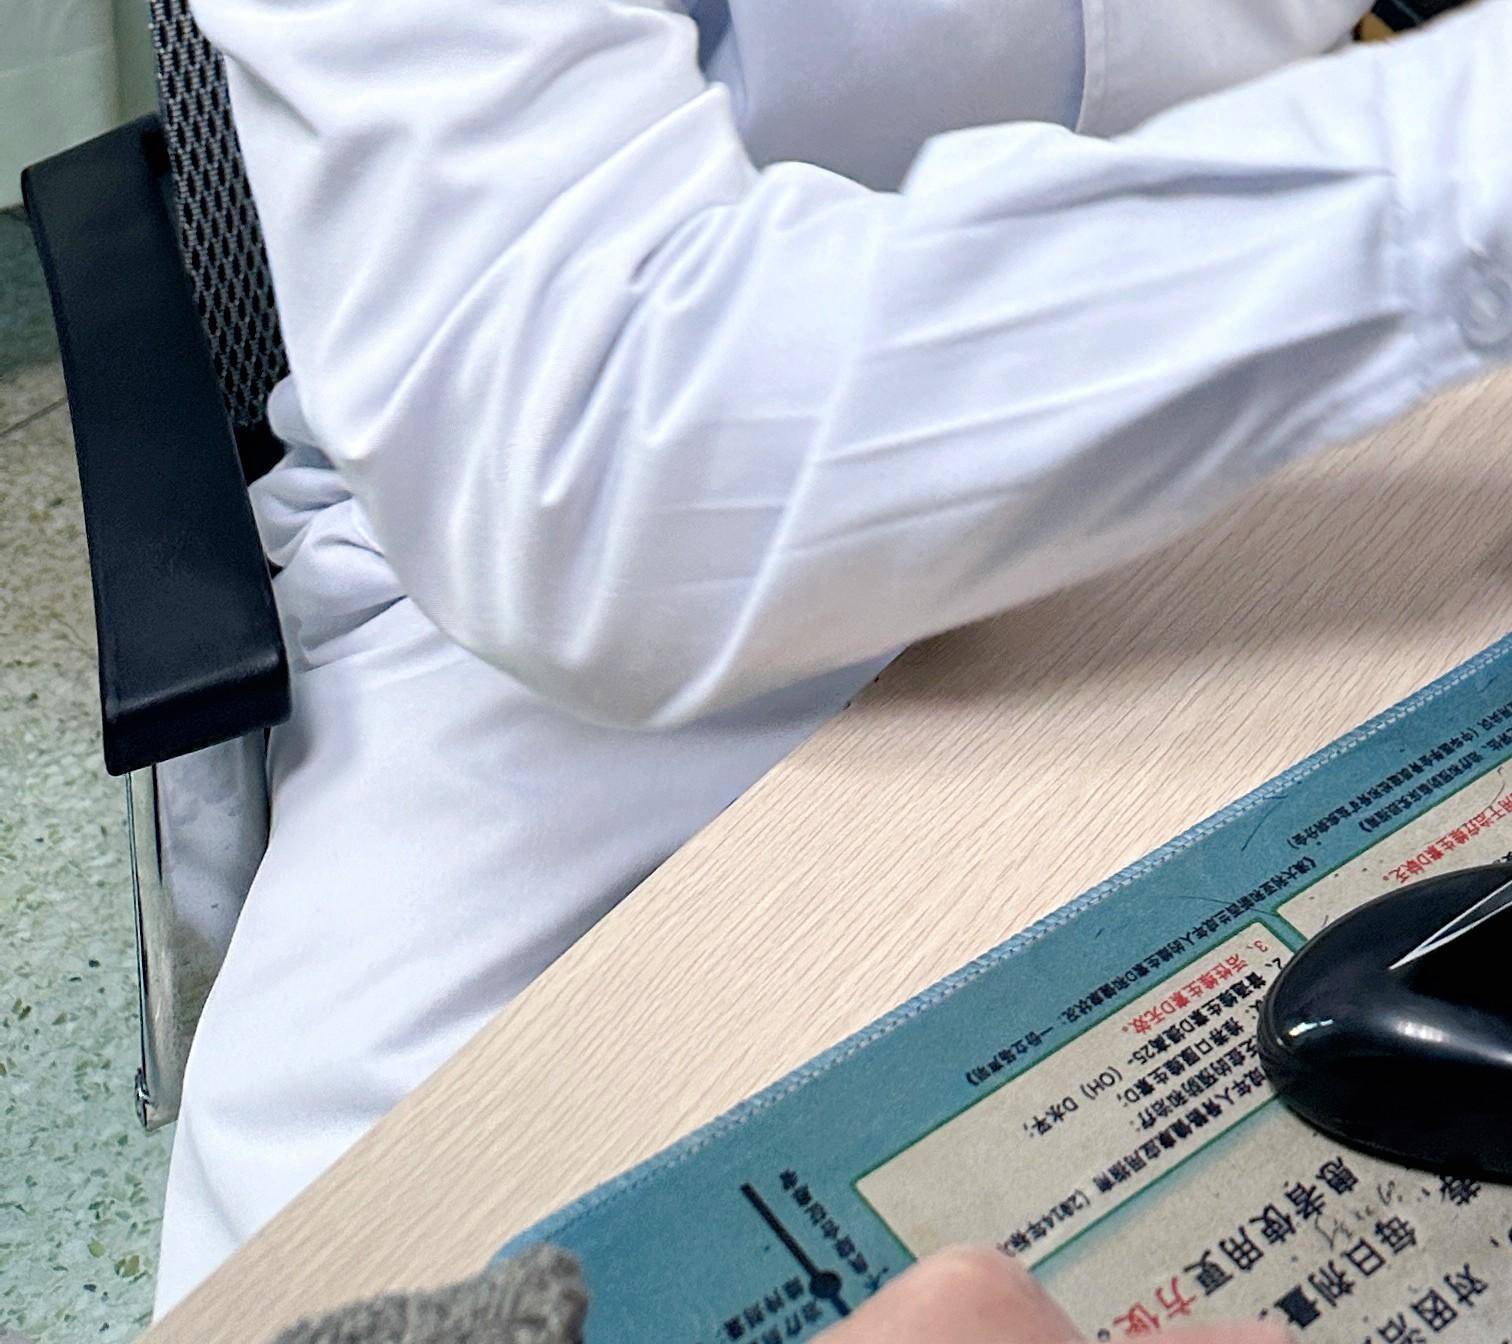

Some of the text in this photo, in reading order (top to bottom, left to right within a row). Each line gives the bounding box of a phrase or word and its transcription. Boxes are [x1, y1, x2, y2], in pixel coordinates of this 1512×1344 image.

[1121, 936, 1269, 1039] 3、活性维生素D无效。
[1128, 1036, 1258, 1134] 乏症的预防和治疗：
[1093, 1155, 1360, 1344] 患者使用更方便。
